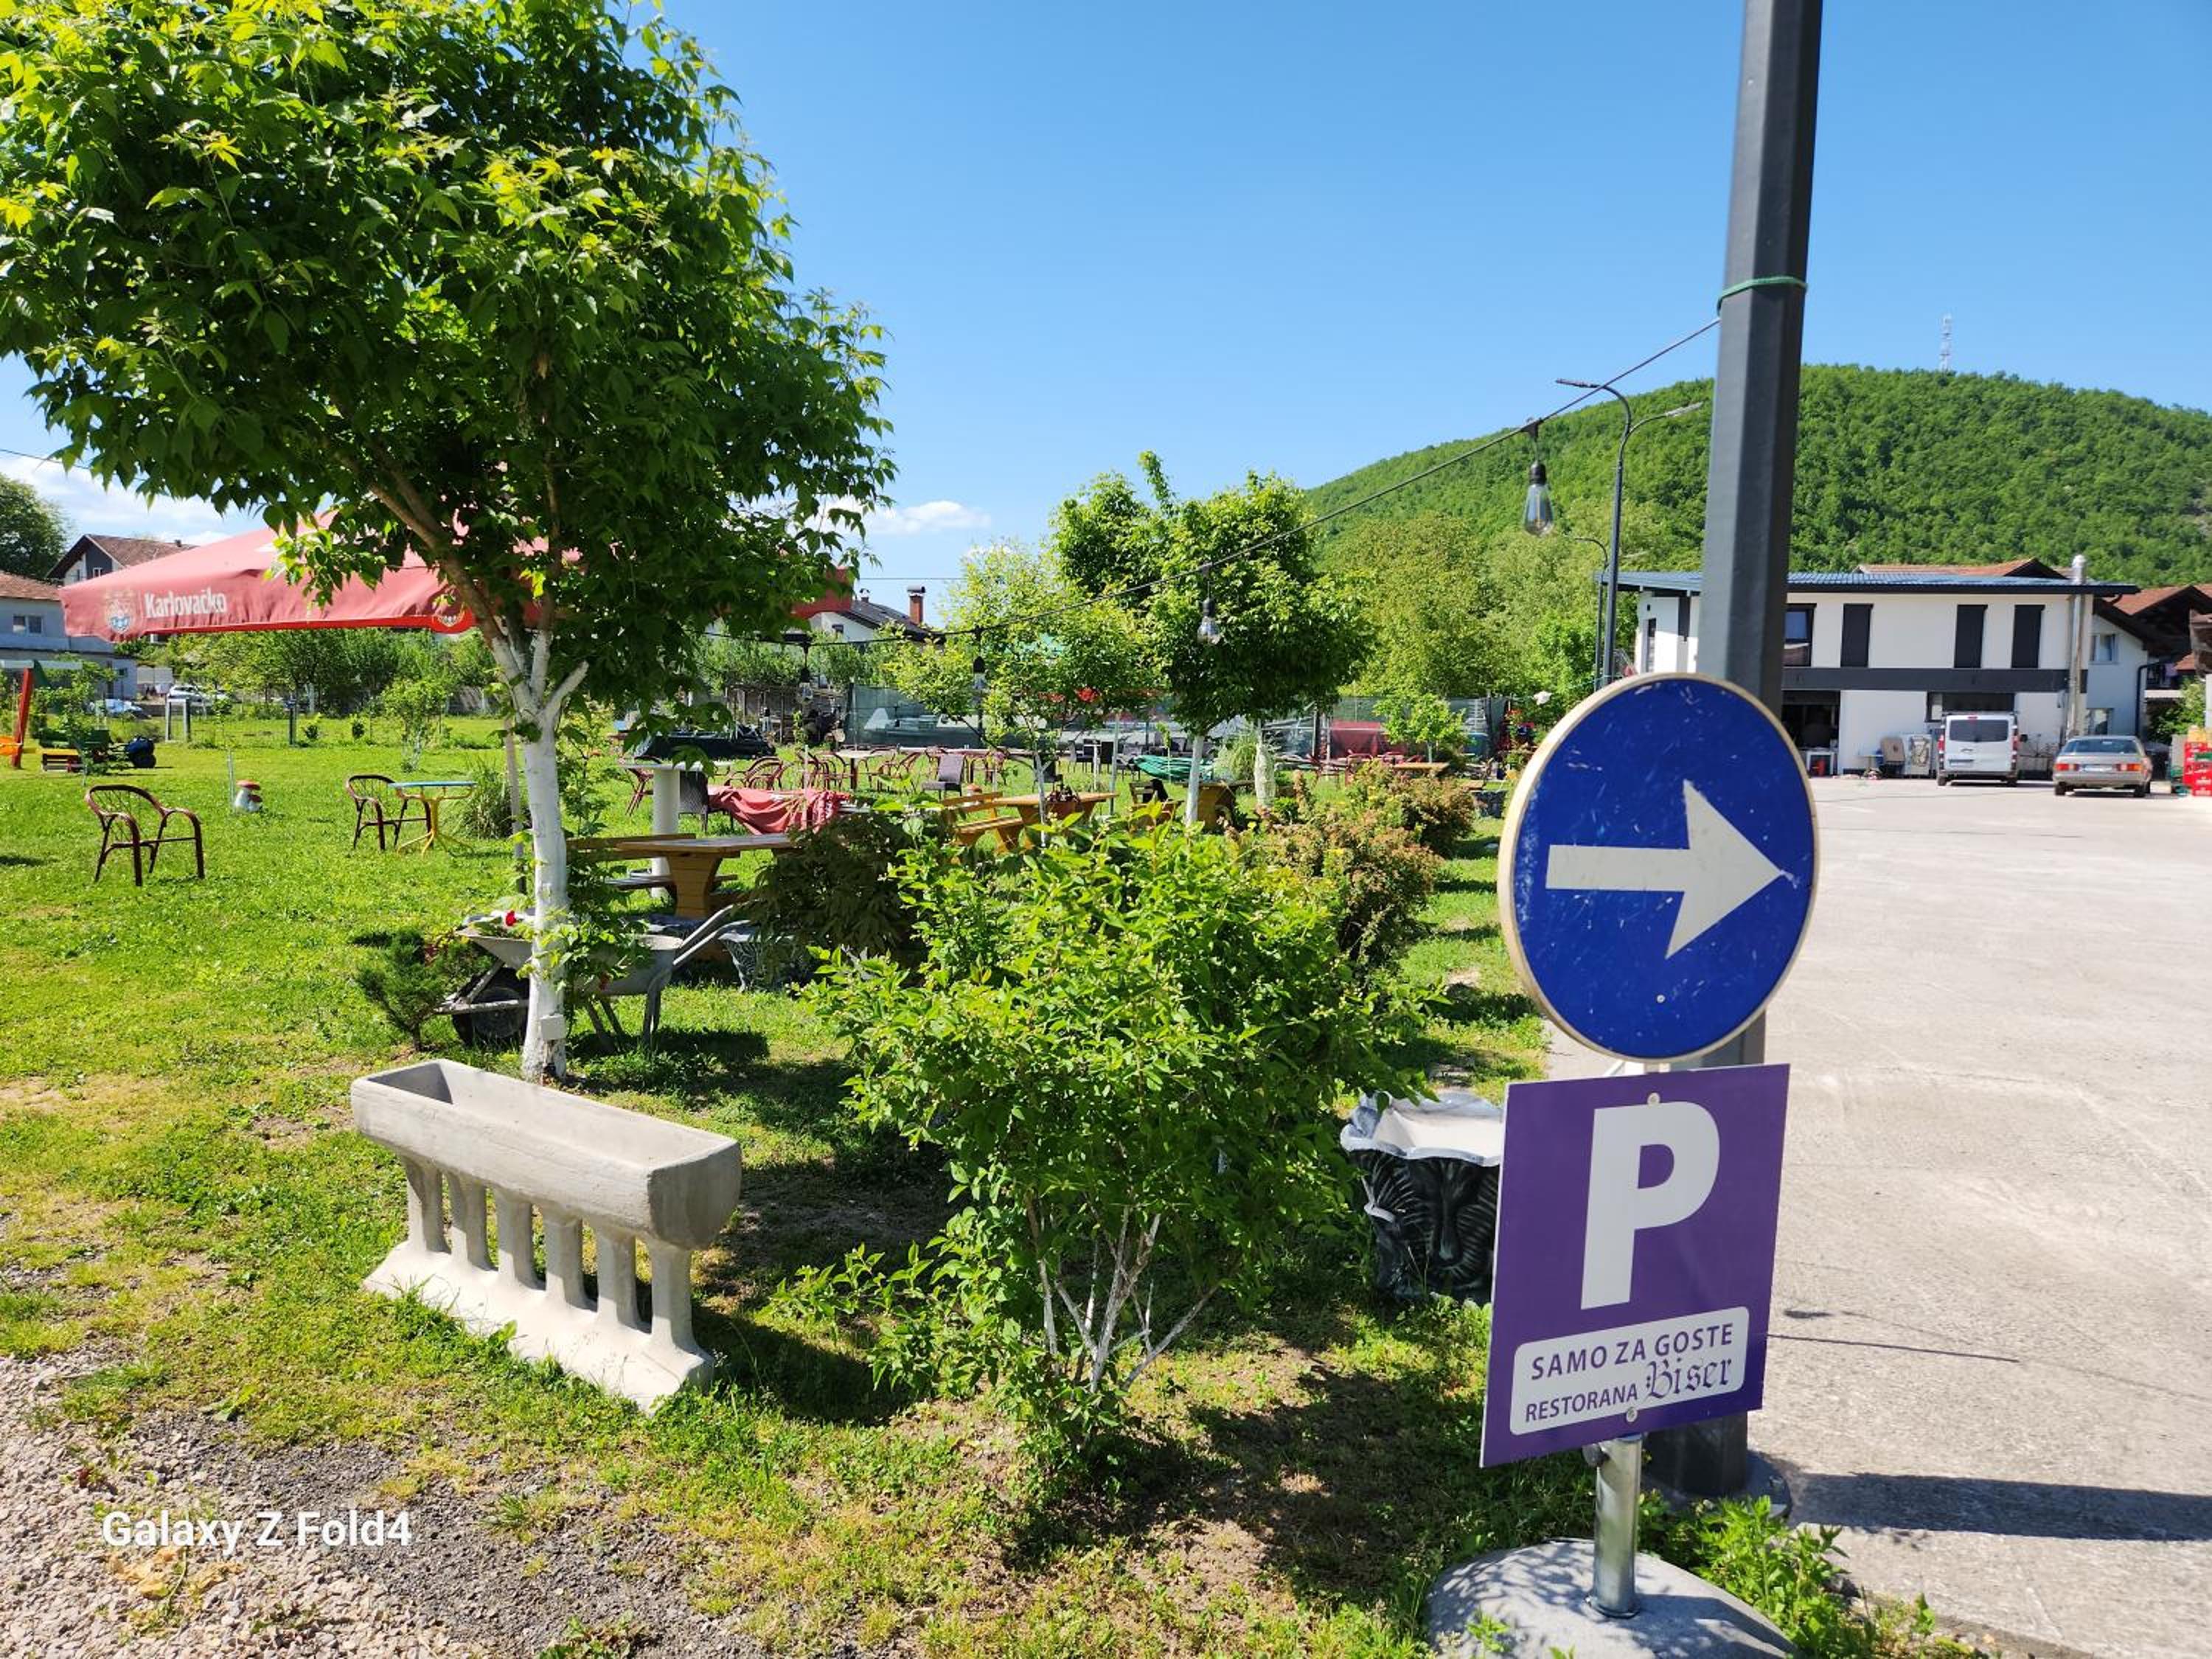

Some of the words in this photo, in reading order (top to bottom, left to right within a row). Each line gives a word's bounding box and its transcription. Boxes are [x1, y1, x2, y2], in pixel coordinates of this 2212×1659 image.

[144, 587, 227, 619] Karlovačko
[1580, 1101, 1720, 1310] P
[1531, 1346, 1607, 1380] SAMO
[1615, 1338, 1646, 1365] ZA
[1655, 1323, 1733, 1357] GOSTE
[1525, 1383, 1638, 1422] RESTORANA
[1645, 1357, 1732, 1399] Biser
